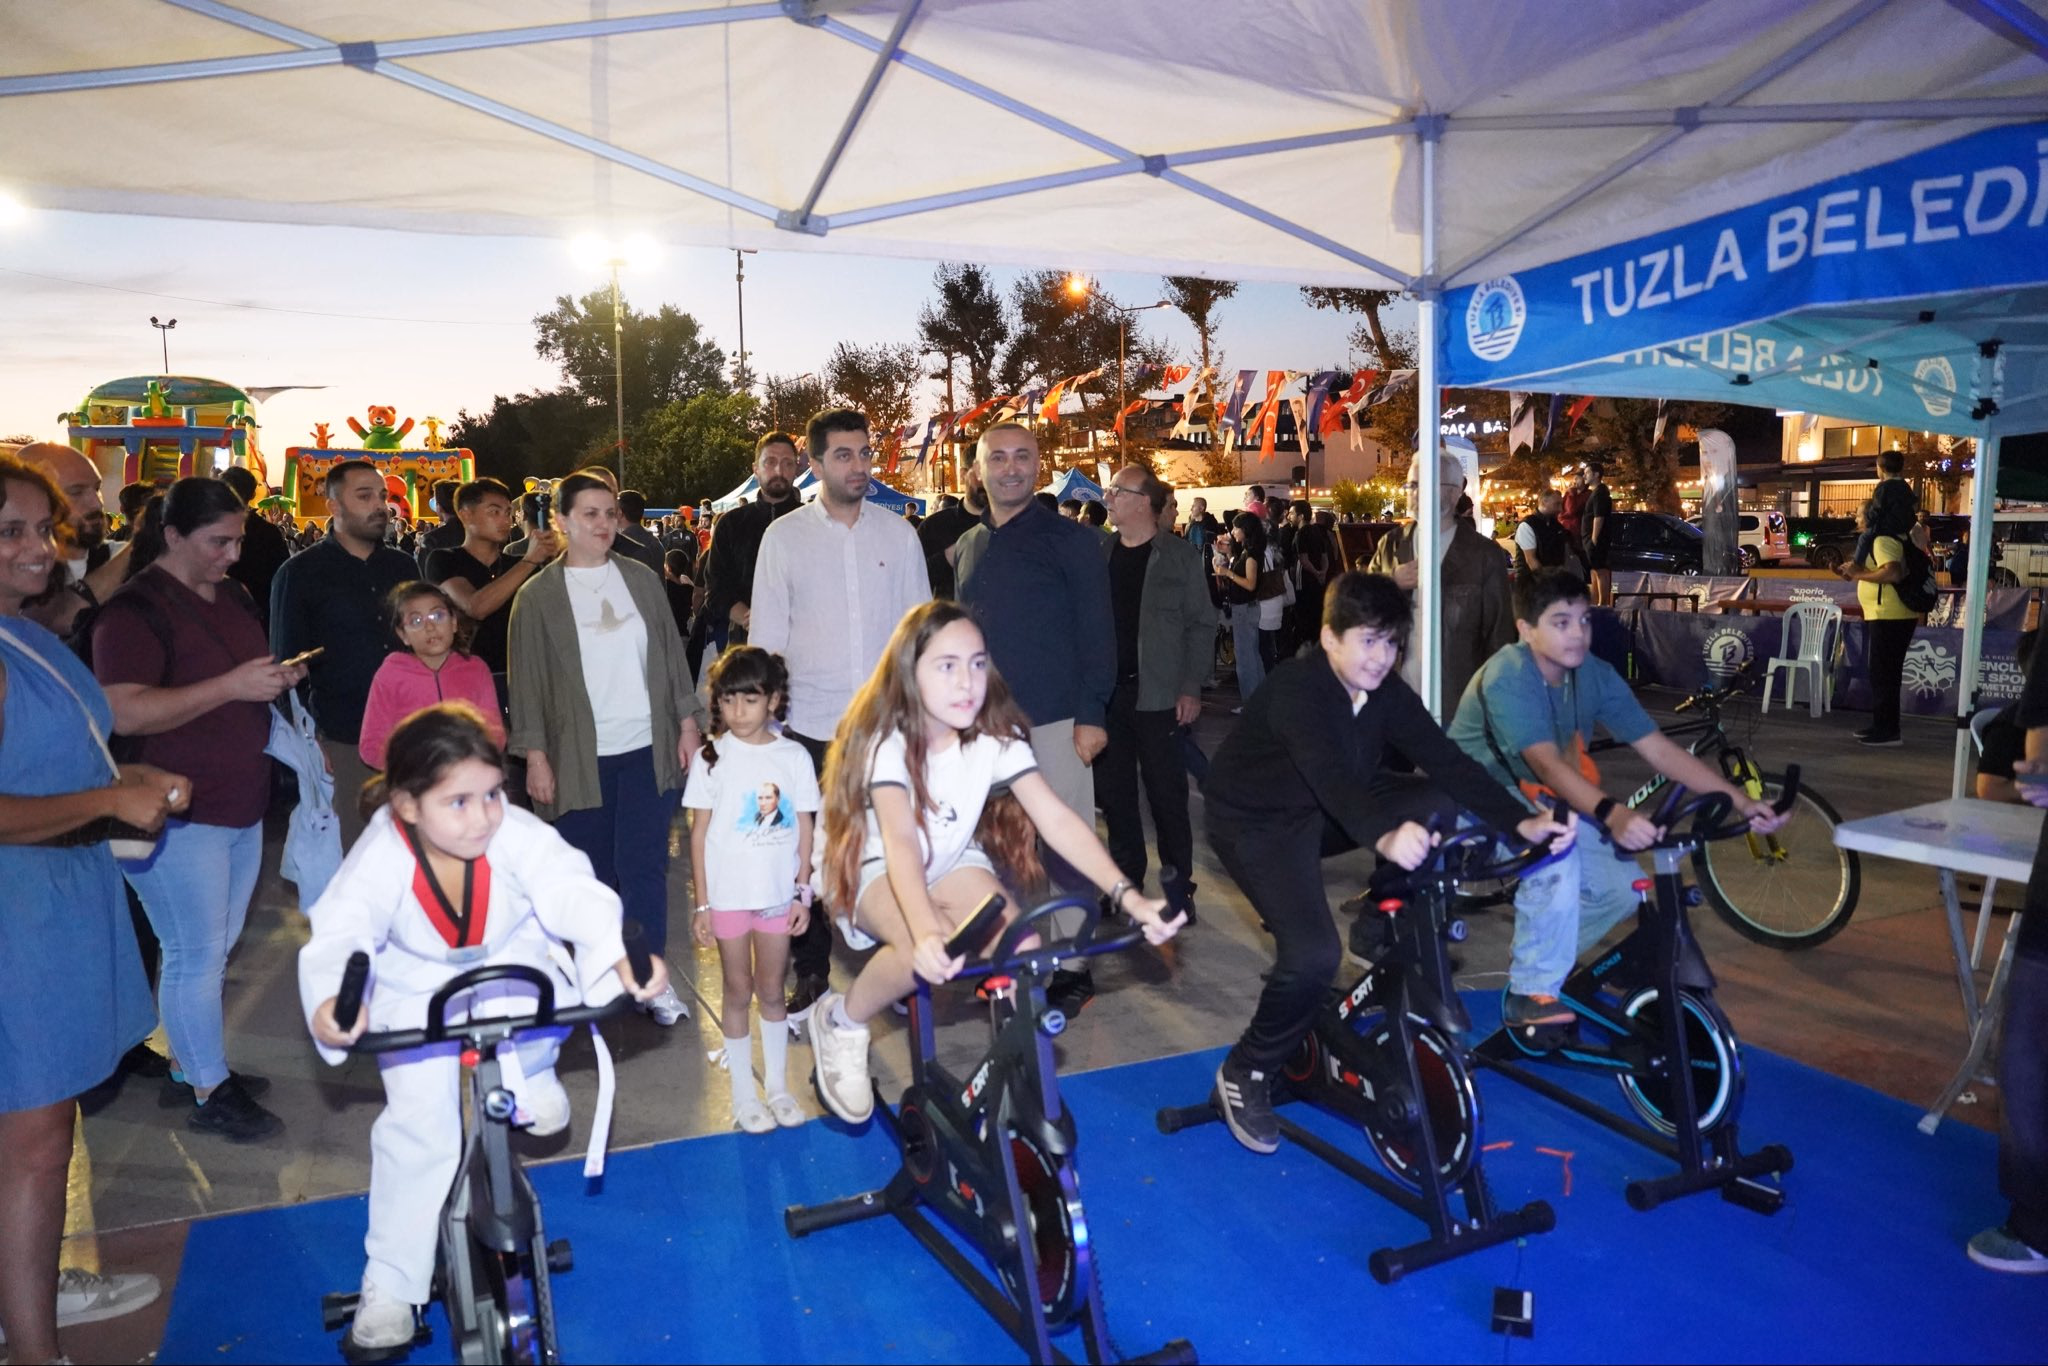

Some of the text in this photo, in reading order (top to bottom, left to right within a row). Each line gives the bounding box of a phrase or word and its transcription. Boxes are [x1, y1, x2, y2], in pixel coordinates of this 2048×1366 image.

[1571, 138, 2048, 325] TUZLA BELEDİ
[1702, 632, 1720, 655] TUZLA
